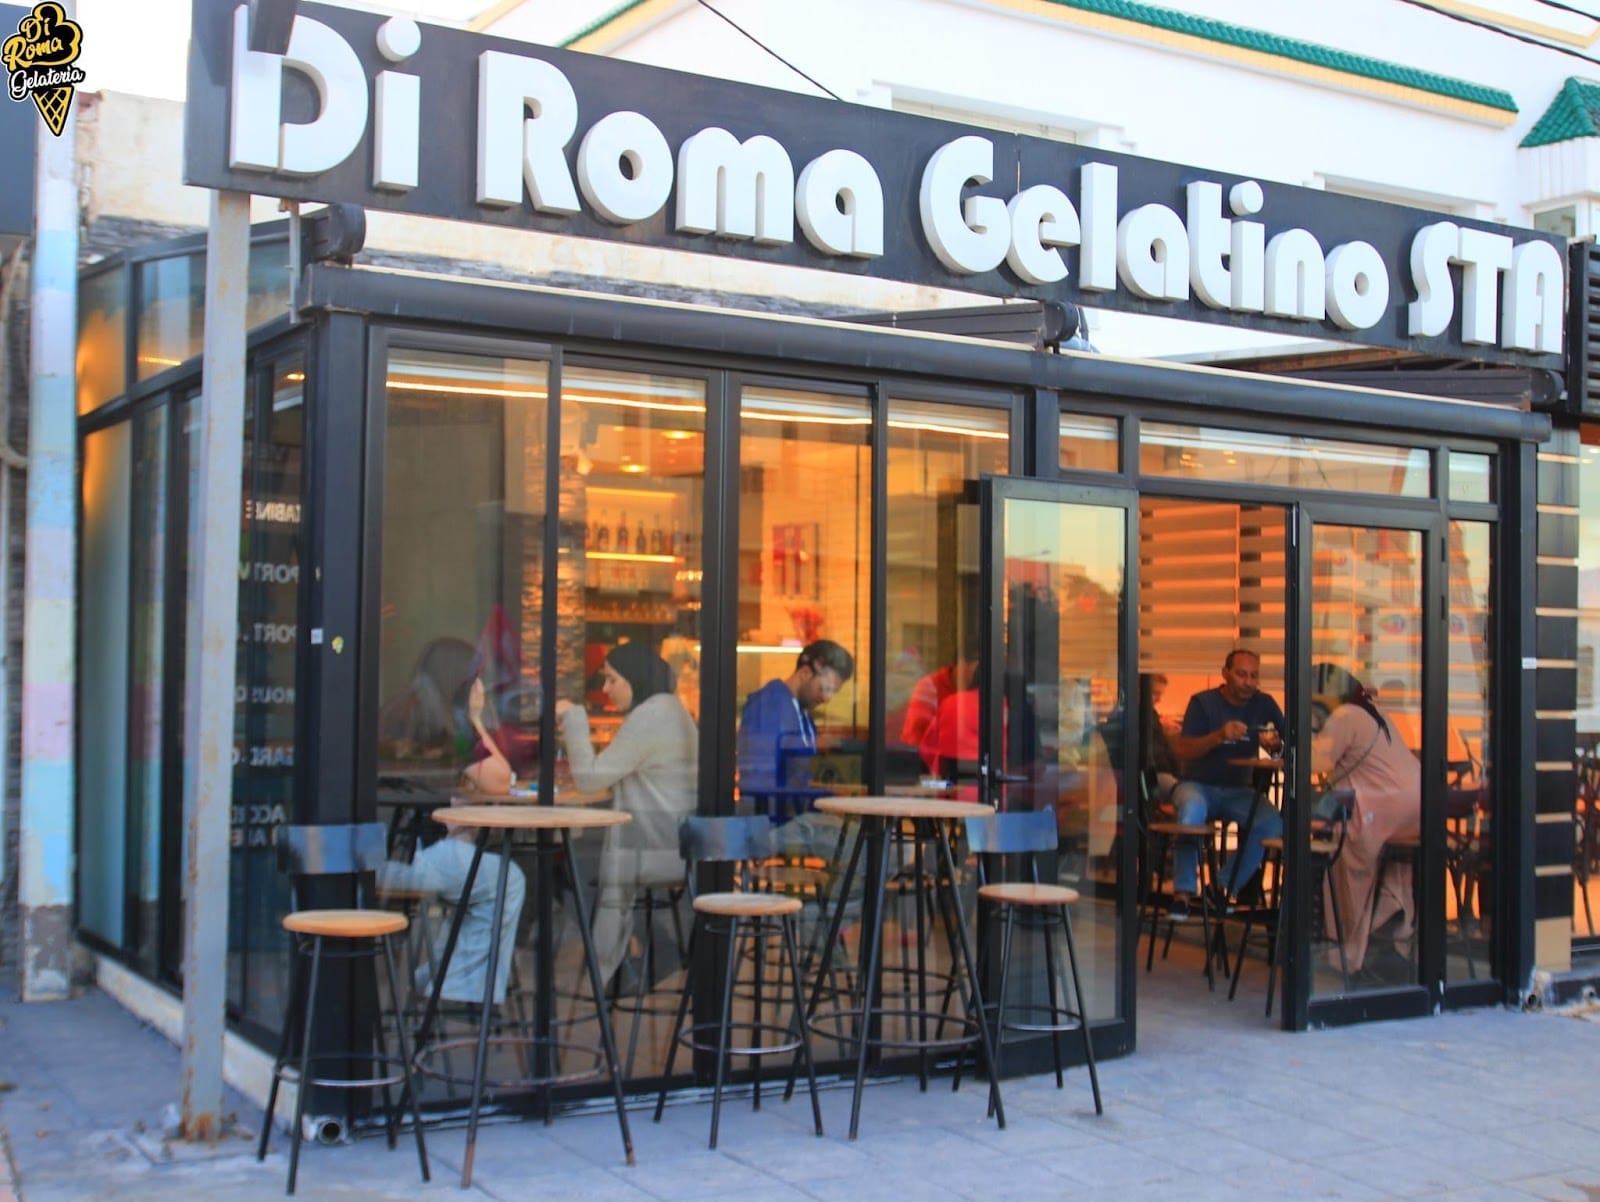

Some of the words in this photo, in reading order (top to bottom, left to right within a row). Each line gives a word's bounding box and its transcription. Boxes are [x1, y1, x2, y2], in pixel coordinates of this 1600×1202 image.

[231, 4, 421, 191] Di
[476, 50, 884, 258] Roma
[920, 135, 1389, 330] Gelatino
[1408, 220, 1564, 354] STA
